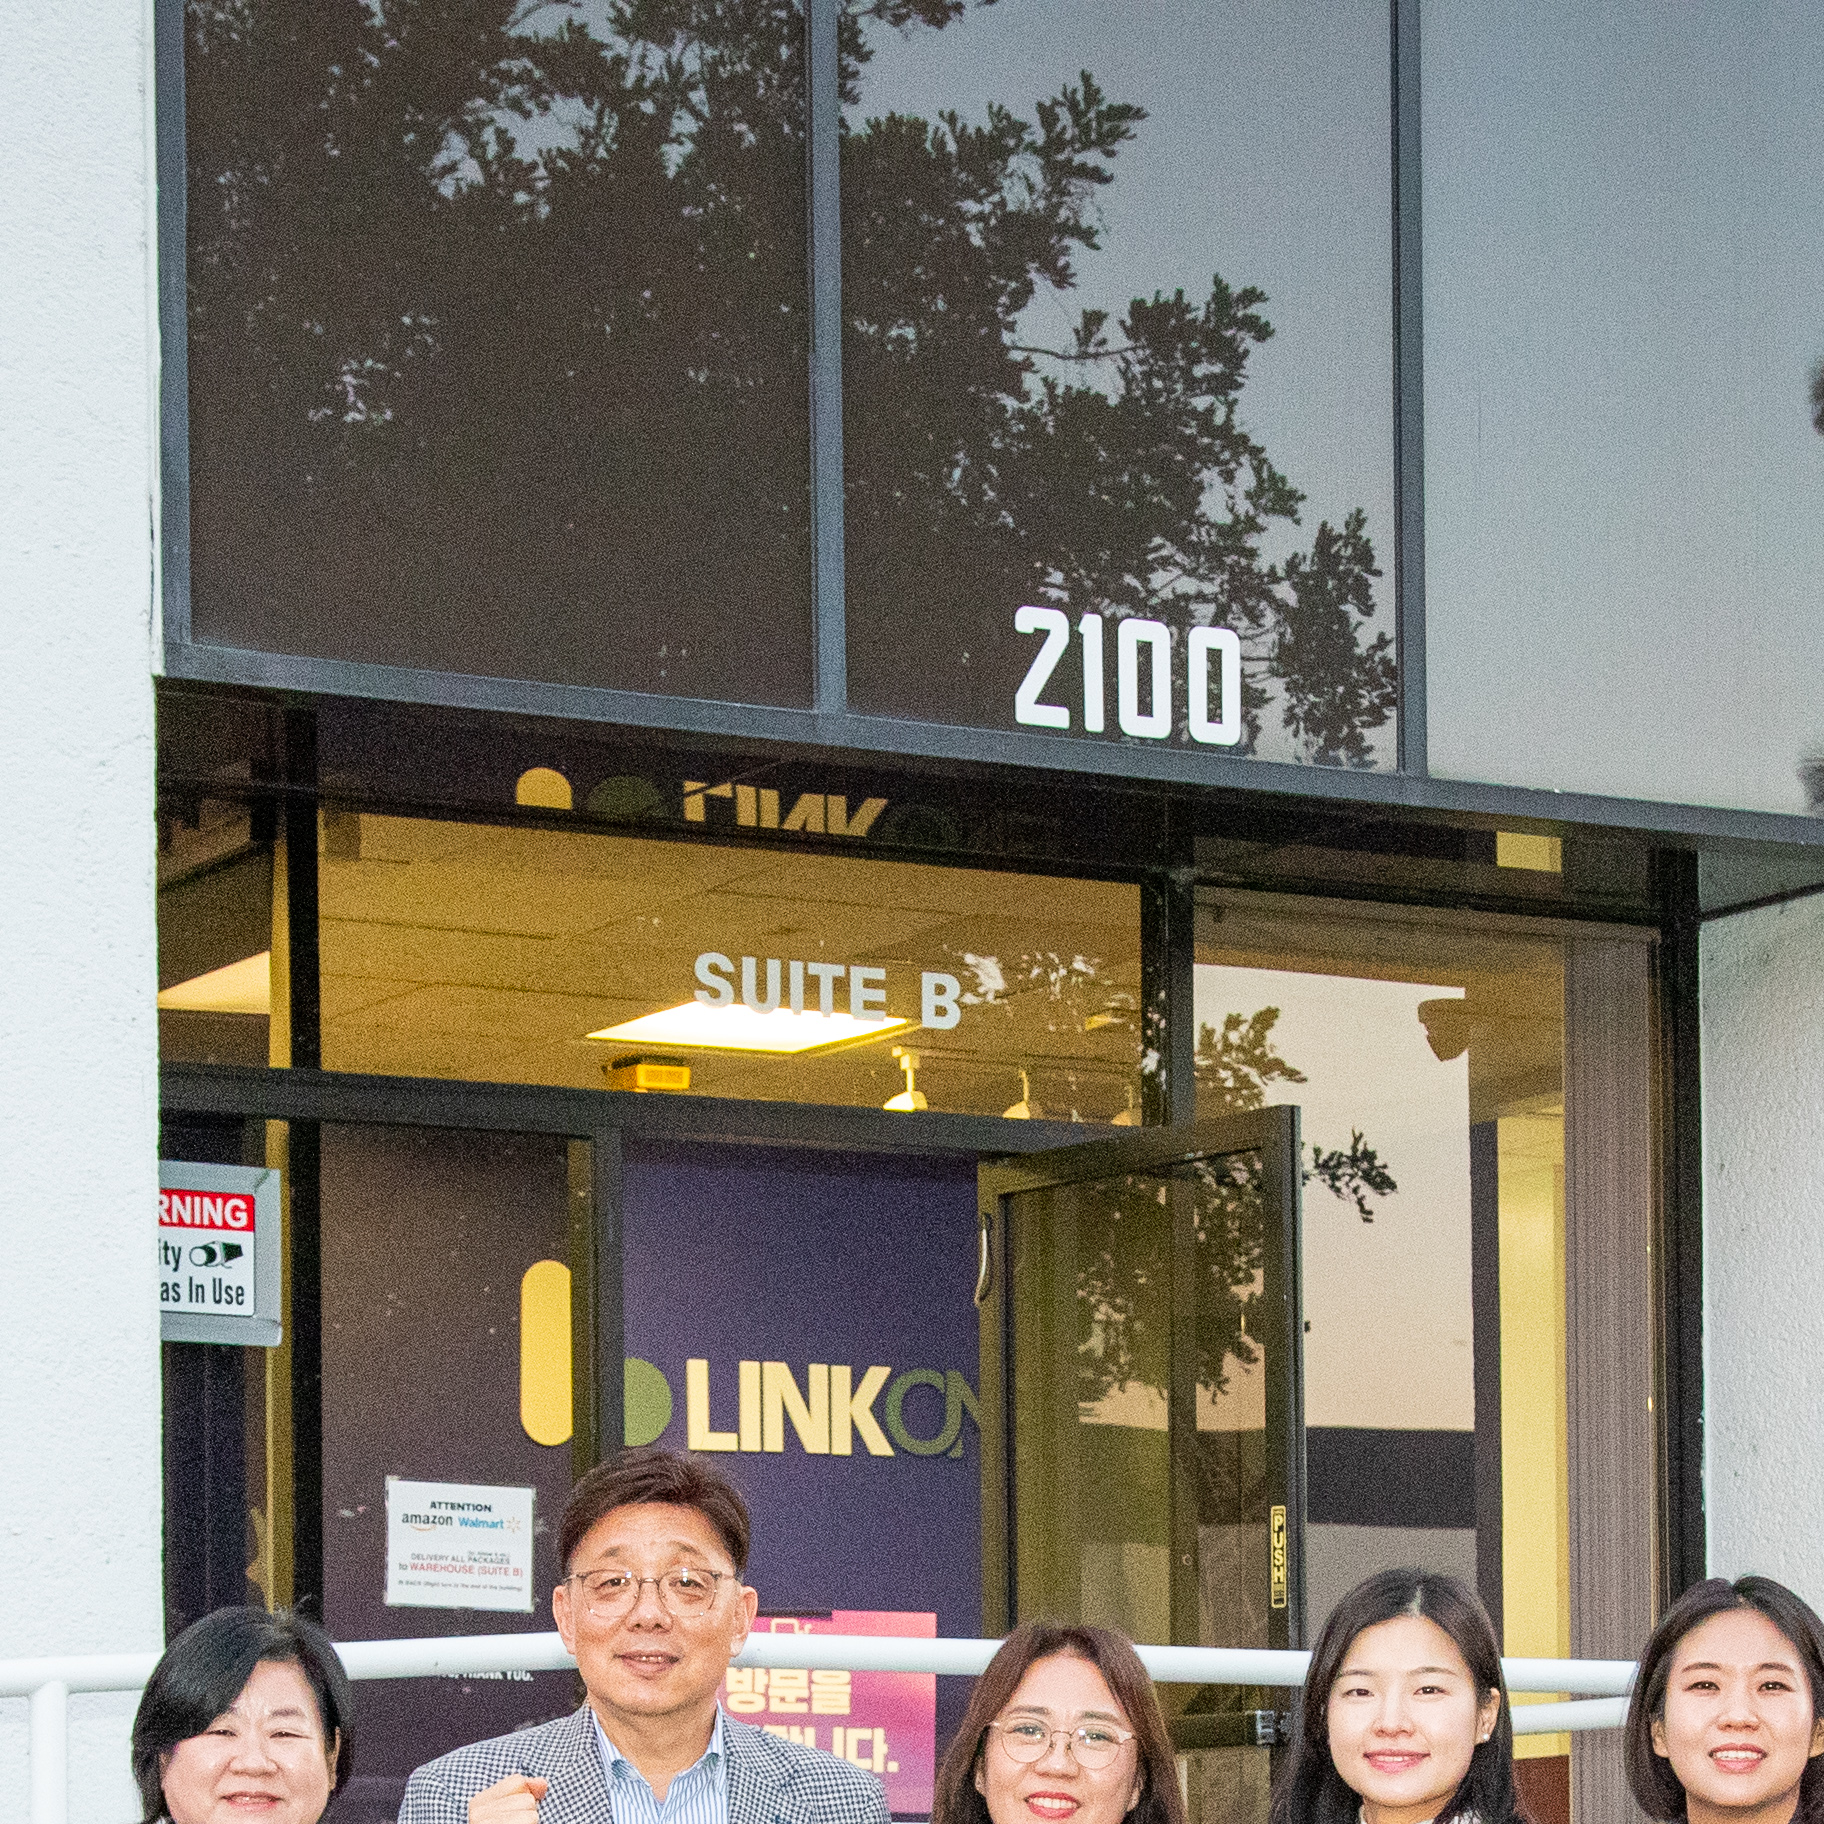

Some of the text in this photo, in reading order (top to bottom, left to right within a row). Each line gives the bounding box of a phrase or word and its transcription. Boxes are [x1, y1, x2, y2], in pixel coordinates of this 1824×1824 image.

[1015, 606, 1241, 747] 2100
[694, 951, 962, 1031] SUITE B
[189, 1275, 206, 1304] In
[212, 1276, 245, 1306] Use
[429, 1501, 492, 1513] ATTENTION
[401, 1513, 504, 1530] amazon Walmart
[451, 1553, 466, 1563] ALL
[1273, 1513, 1285, 1583] PUSH
[410, 1563, 475, 1575] WAREHOUSE
[477, 1565, 510, 1577] (SUITE
